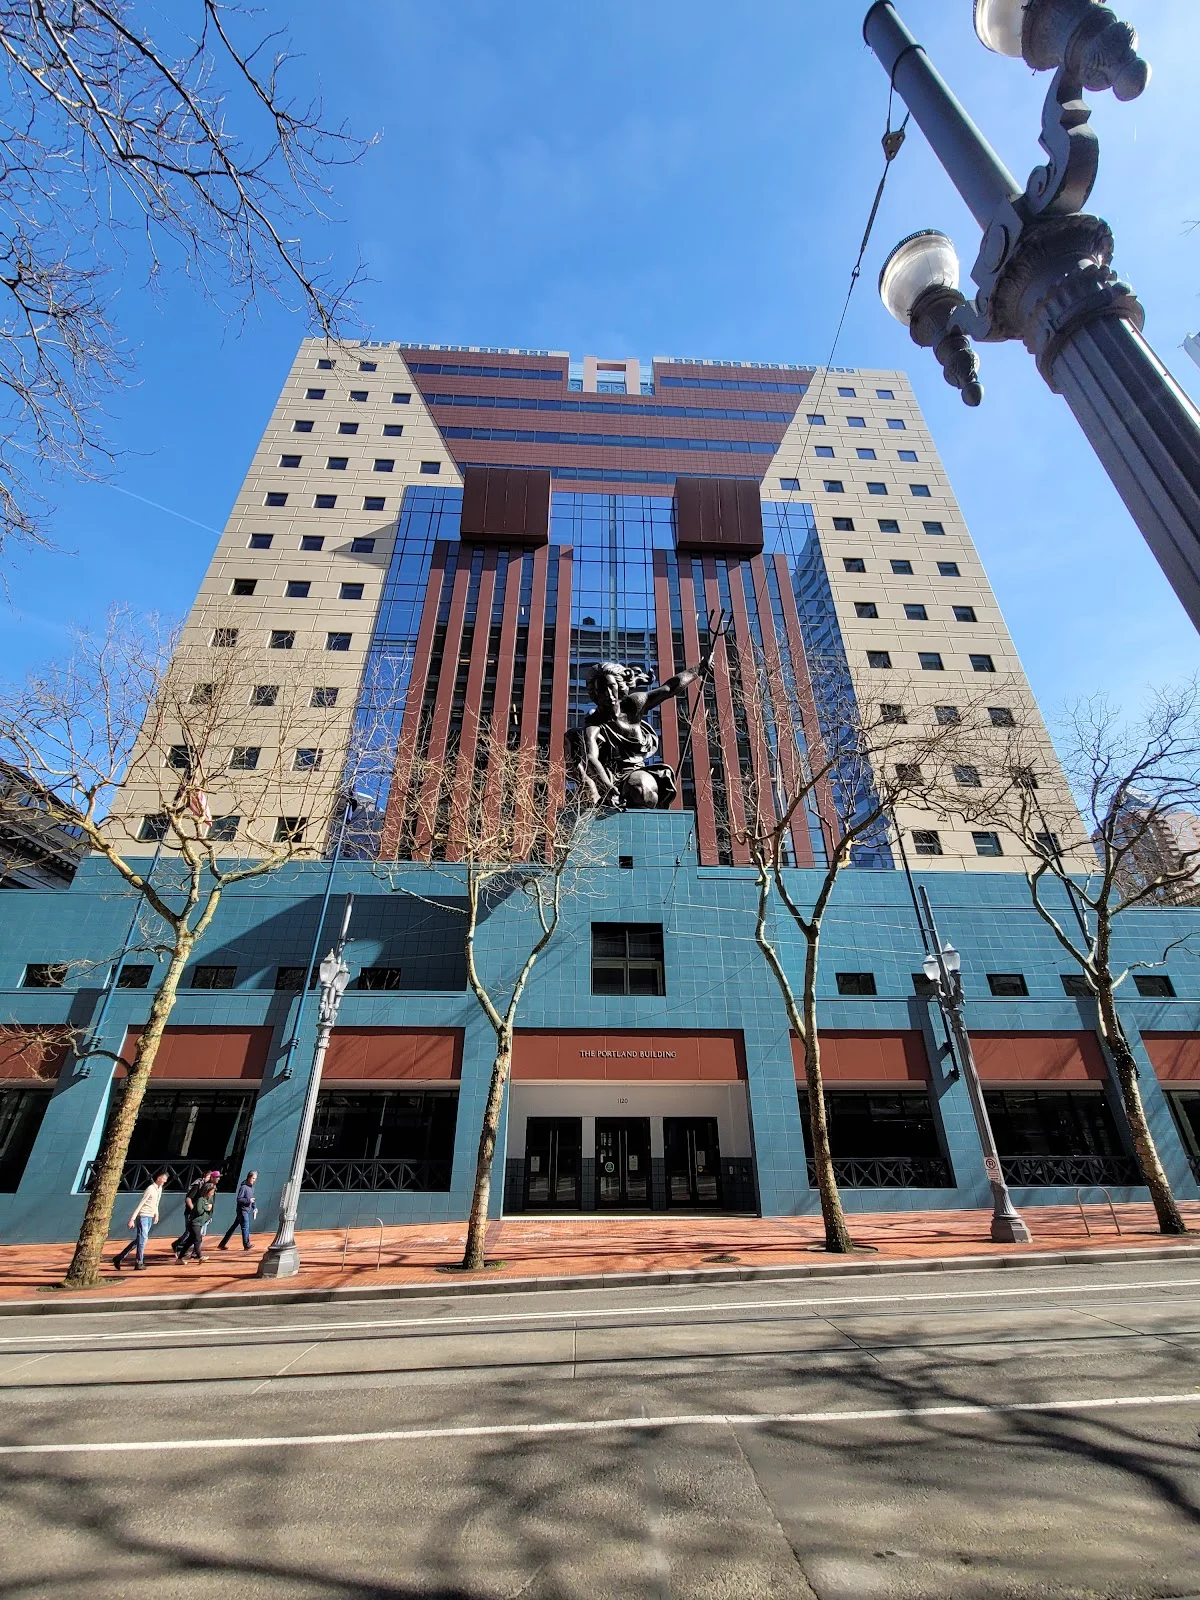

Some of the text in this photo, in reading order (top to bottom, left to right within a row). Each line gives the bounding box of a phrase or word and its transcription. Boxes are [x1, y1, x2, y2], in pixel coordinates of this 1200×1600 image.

[579, 1050, 677, 1059] THE PORTLAND BUILDING
